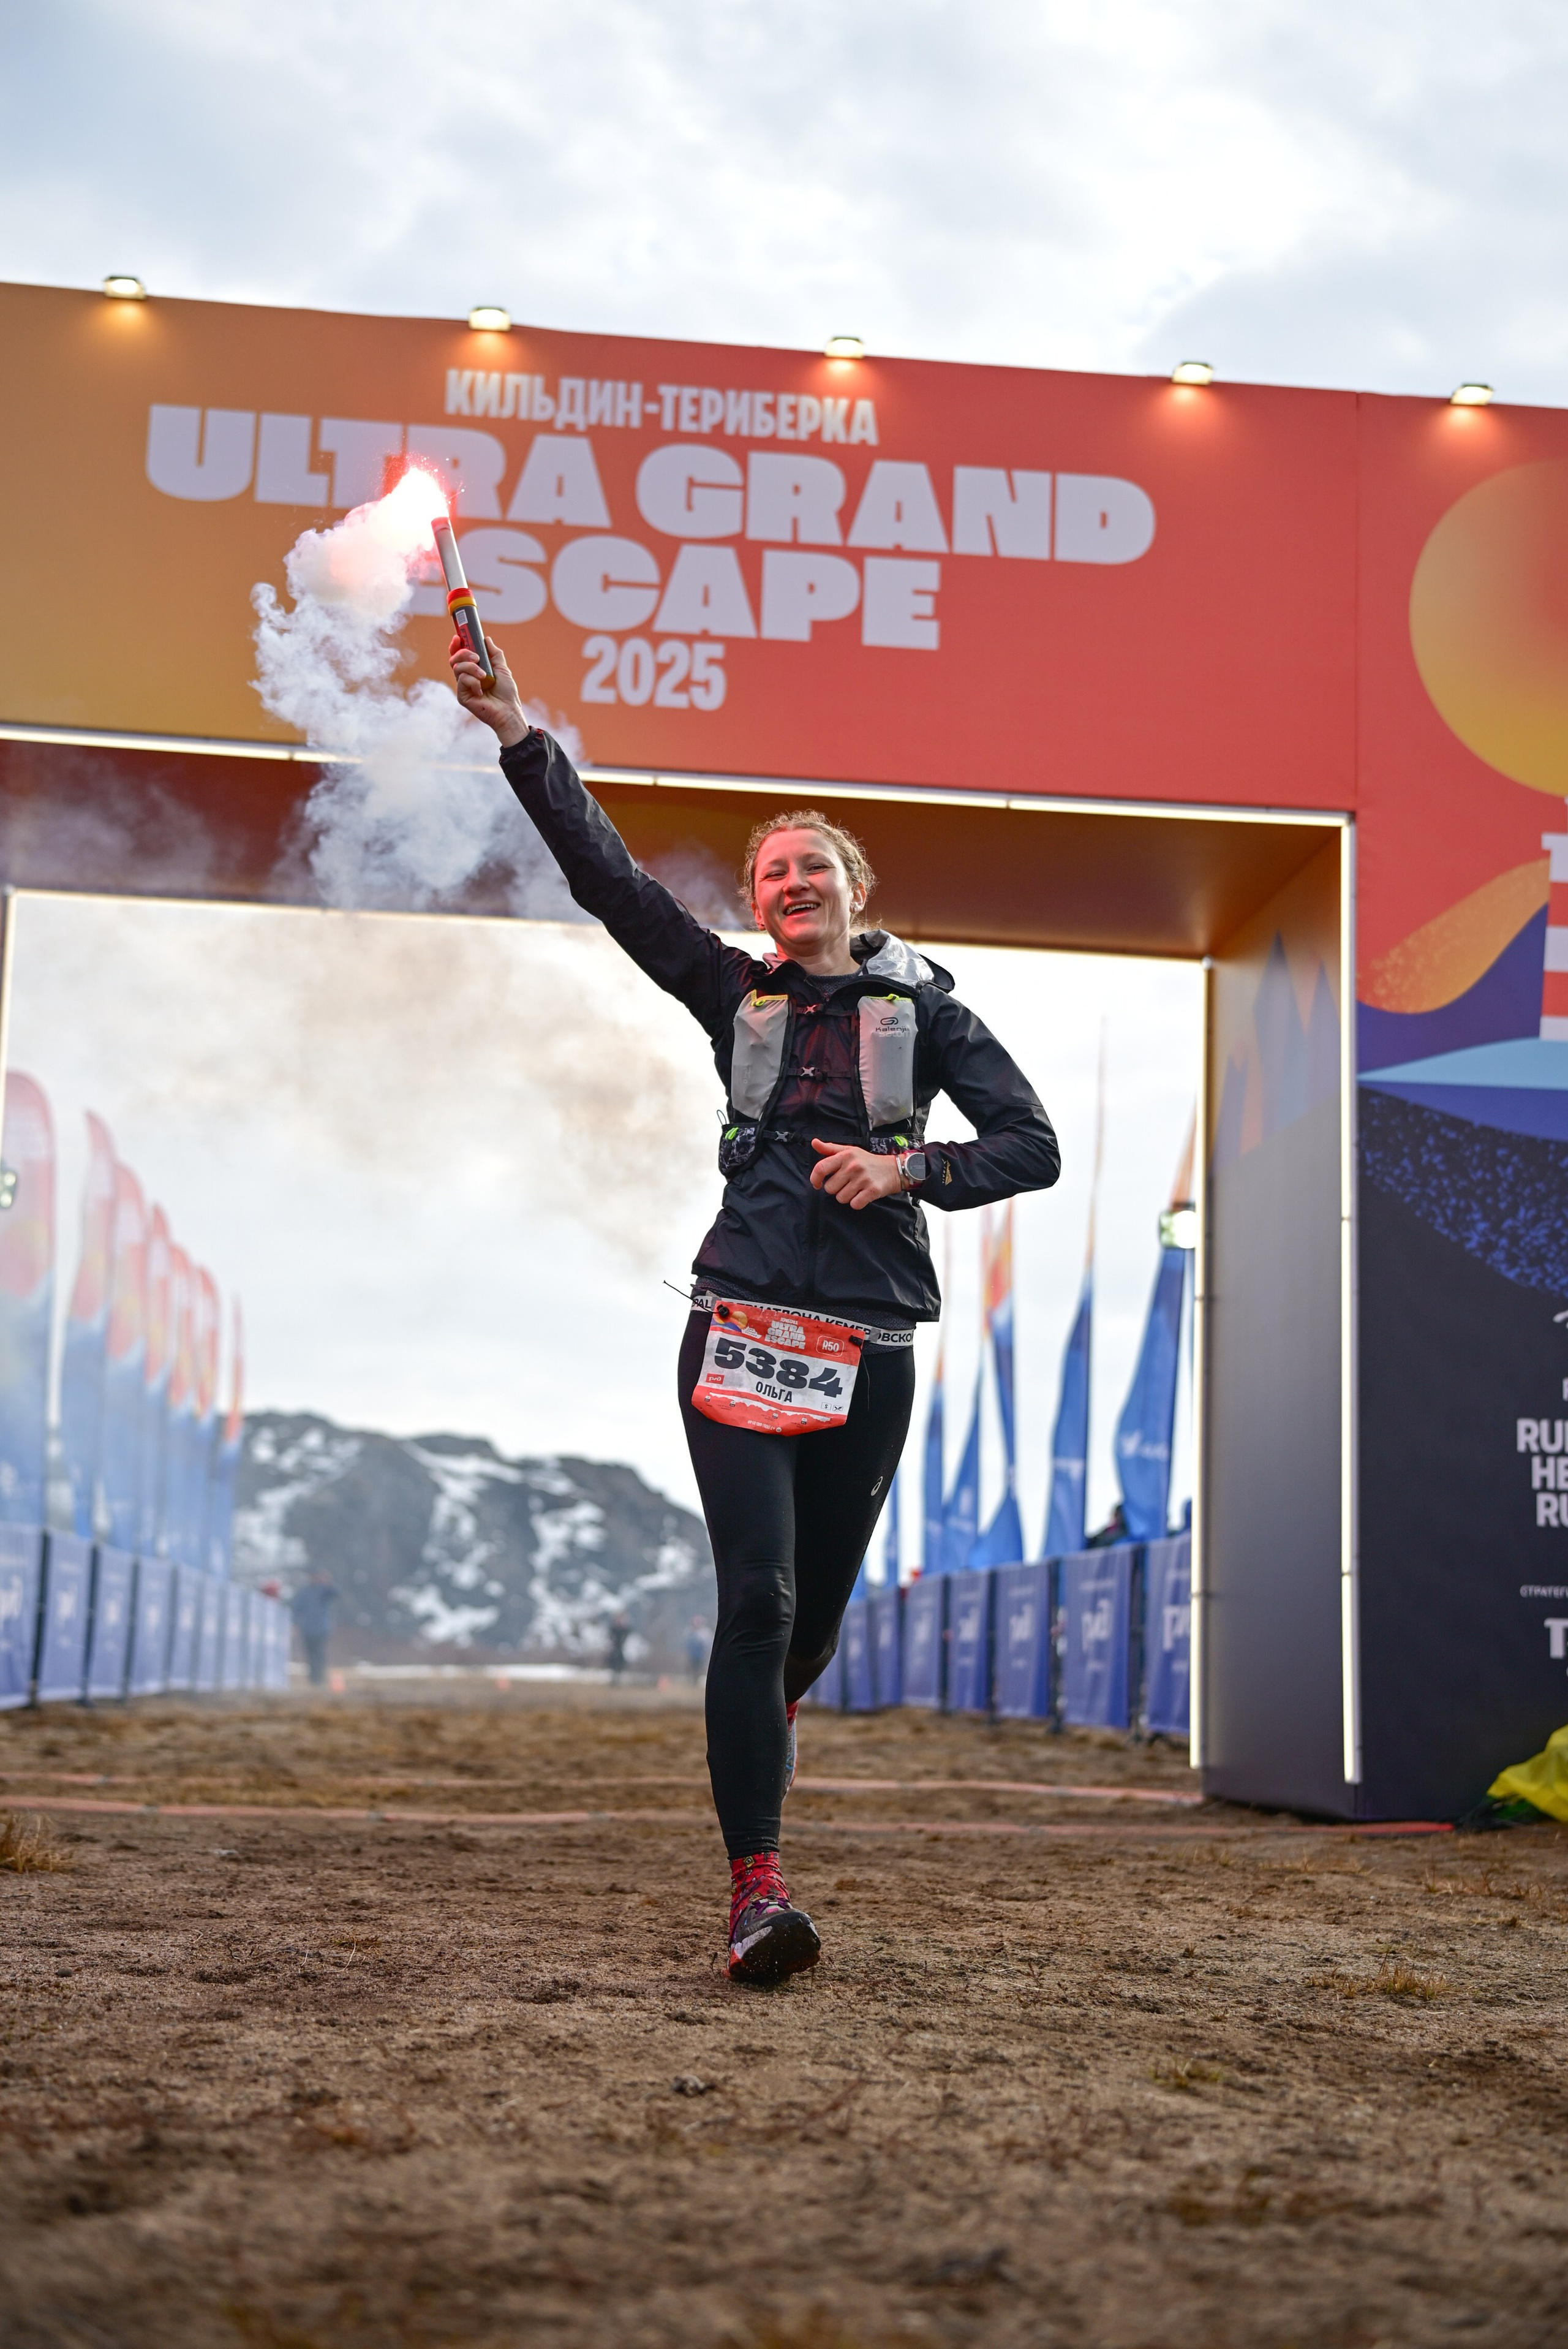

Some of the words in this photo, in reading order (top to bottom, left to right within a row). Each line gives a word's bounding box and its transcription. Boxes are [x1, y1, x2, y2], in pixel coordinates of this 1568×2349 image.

[445, 368, 878, 446] КИЛЬДИН-ТЕРИБЕРКА
[145, 404, 611, 528] ULTRA
[635, 443, 1156, 565] GRAND
[402, 527, 940, 650] SCAPE
[581, 635, 726, 711] 2025
[764, 1334, 805, 1349] ESCAPE
[767, 1328, 805, 1342] GRAND
[771, 1321, 804, 1334] ULTRA
[822, 1340, 839, 1352] R50
[714, 1337, 843, 1398] 5384
[756, 1381, 793, 1403] ОЛЬГА
[1516, 1418, 1568, 1454] RU
